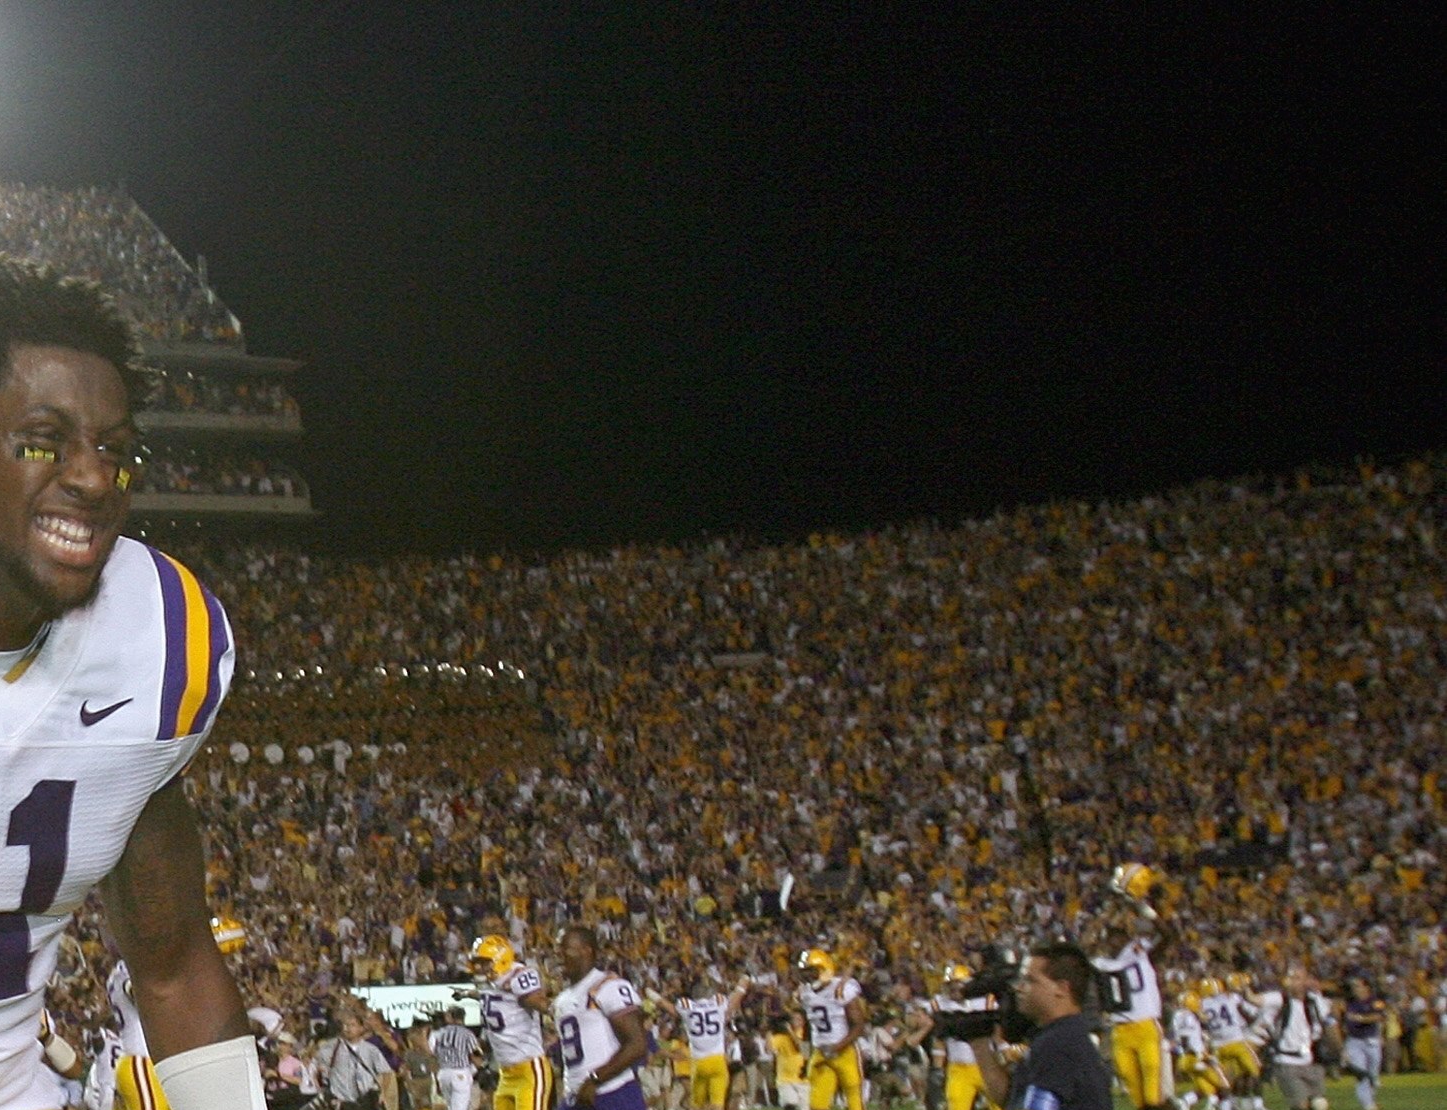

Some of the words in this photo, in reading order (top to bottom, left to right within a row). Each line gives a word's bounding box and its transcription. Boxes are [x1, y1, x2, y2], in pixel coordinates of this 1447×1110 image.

[518, 972, 539, 990] 85
[619, 985, 634, 1006] 9
[689, 1010, 720, 1037] 35
[812, 1005, 832, 1033] 3
[560, 1015, 585, 1068] 9
